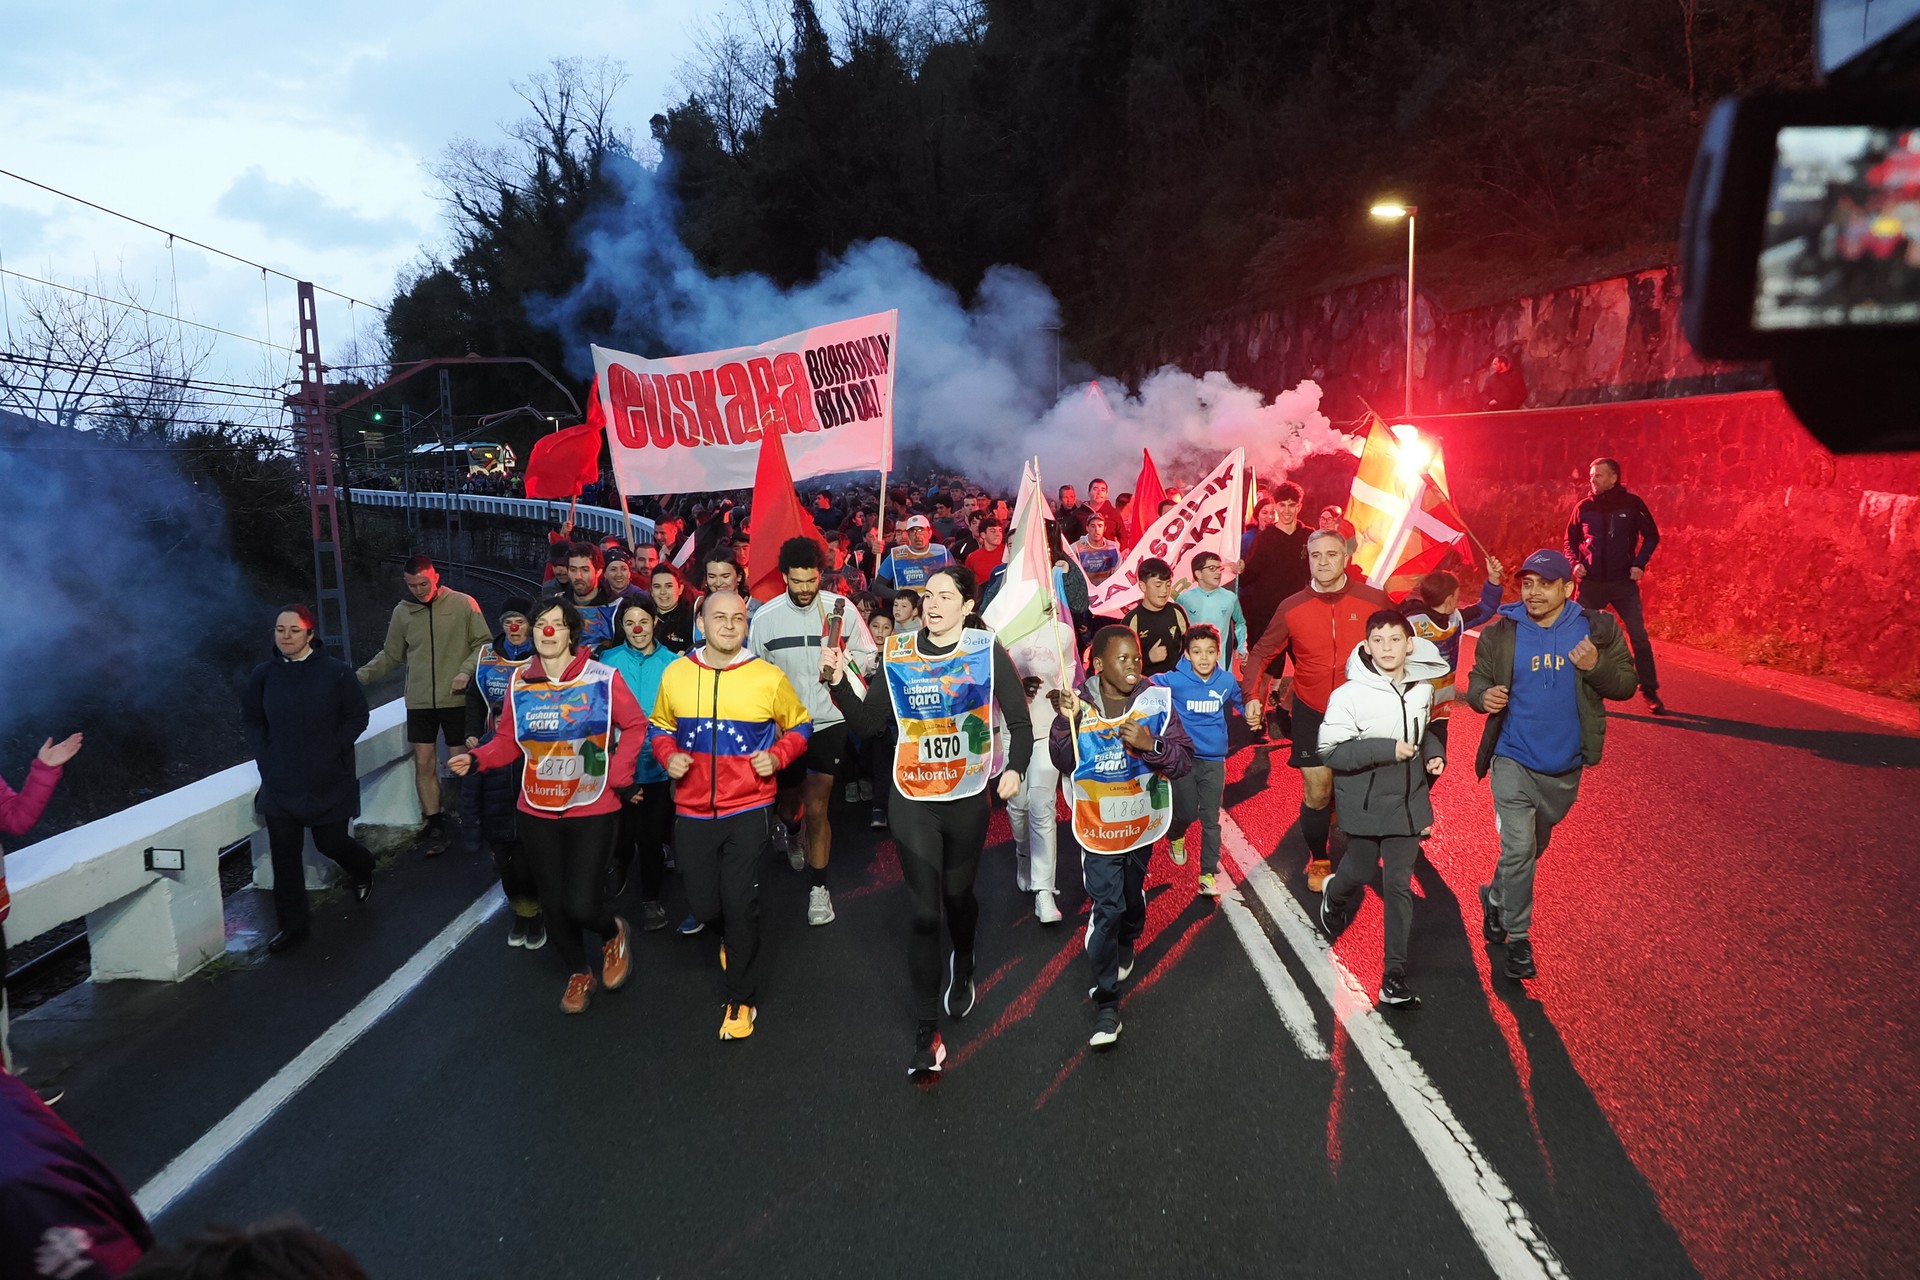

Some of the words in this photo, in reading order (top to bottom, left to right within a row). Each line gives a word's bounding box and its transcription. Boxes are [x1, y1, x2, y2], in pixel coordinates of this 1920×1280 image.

[814, 384, 855, 429] BIZI
[847, 378, 882, 421] DA!
[1531, 653, 1565, 671] GAP
[903, 684, 939, 695] Euskara
[908, 694, 941, 709] gara
[1186, 700, 1220, 713] PUMA
[525, 711, 559, 720] Euskara
[528, 720, 560, 732] gara
[924, 735, 960, 759] 1870
[538, 758, 577, 777] 1870
[1094, 758, 1127, 773] gara
[902, 766, 958, 781] 24.korrika
[526, 782, 571, 797] 24.korrika
[1108, 798, 1146, 818] 1868
[1082, 825, 1141, 839] 24.korrika
